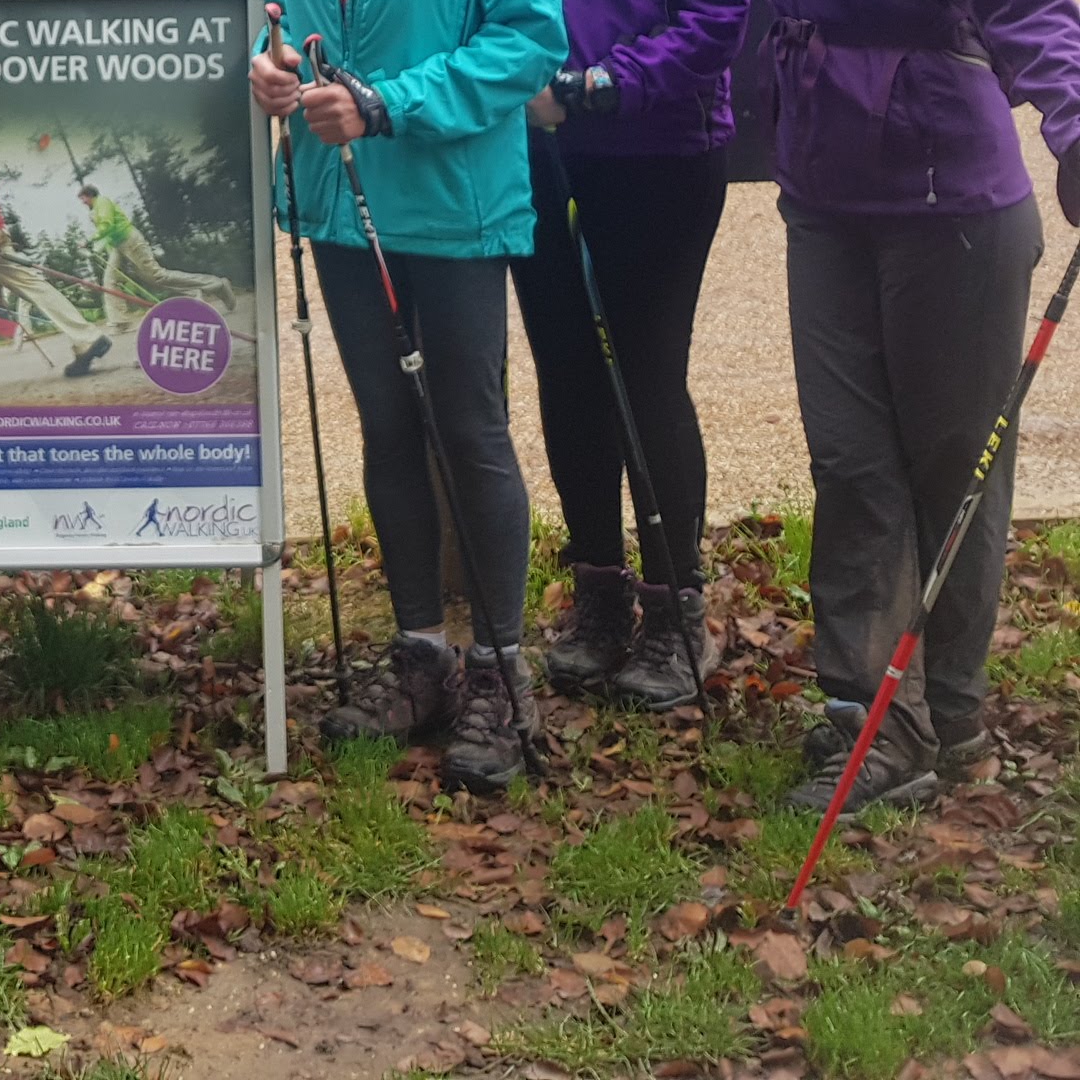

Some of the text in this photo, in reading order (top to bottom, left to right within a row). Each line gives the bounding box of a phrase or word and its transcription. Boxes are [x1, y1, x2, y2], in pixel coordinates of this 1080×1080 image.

[26, 17, 179, 47] WALKING
[187, 16, 231, 44] AT
[96, 52, 225, 82] WOODS
[150, 317, 221, 346] MEET
[149, 344, 216, 372] HERE
[9, 447, 45, 463] that
[49, 448, 101, 463] tones
[103, 446, 134, 462] the
[139, 444, 195, 462] whole
[199, 444, 251, 465] body!
[974, 414, 1010, 481] LEKI
[166, 495, 257, 523] nordic
[164, 522, 240, 537] WALKING
